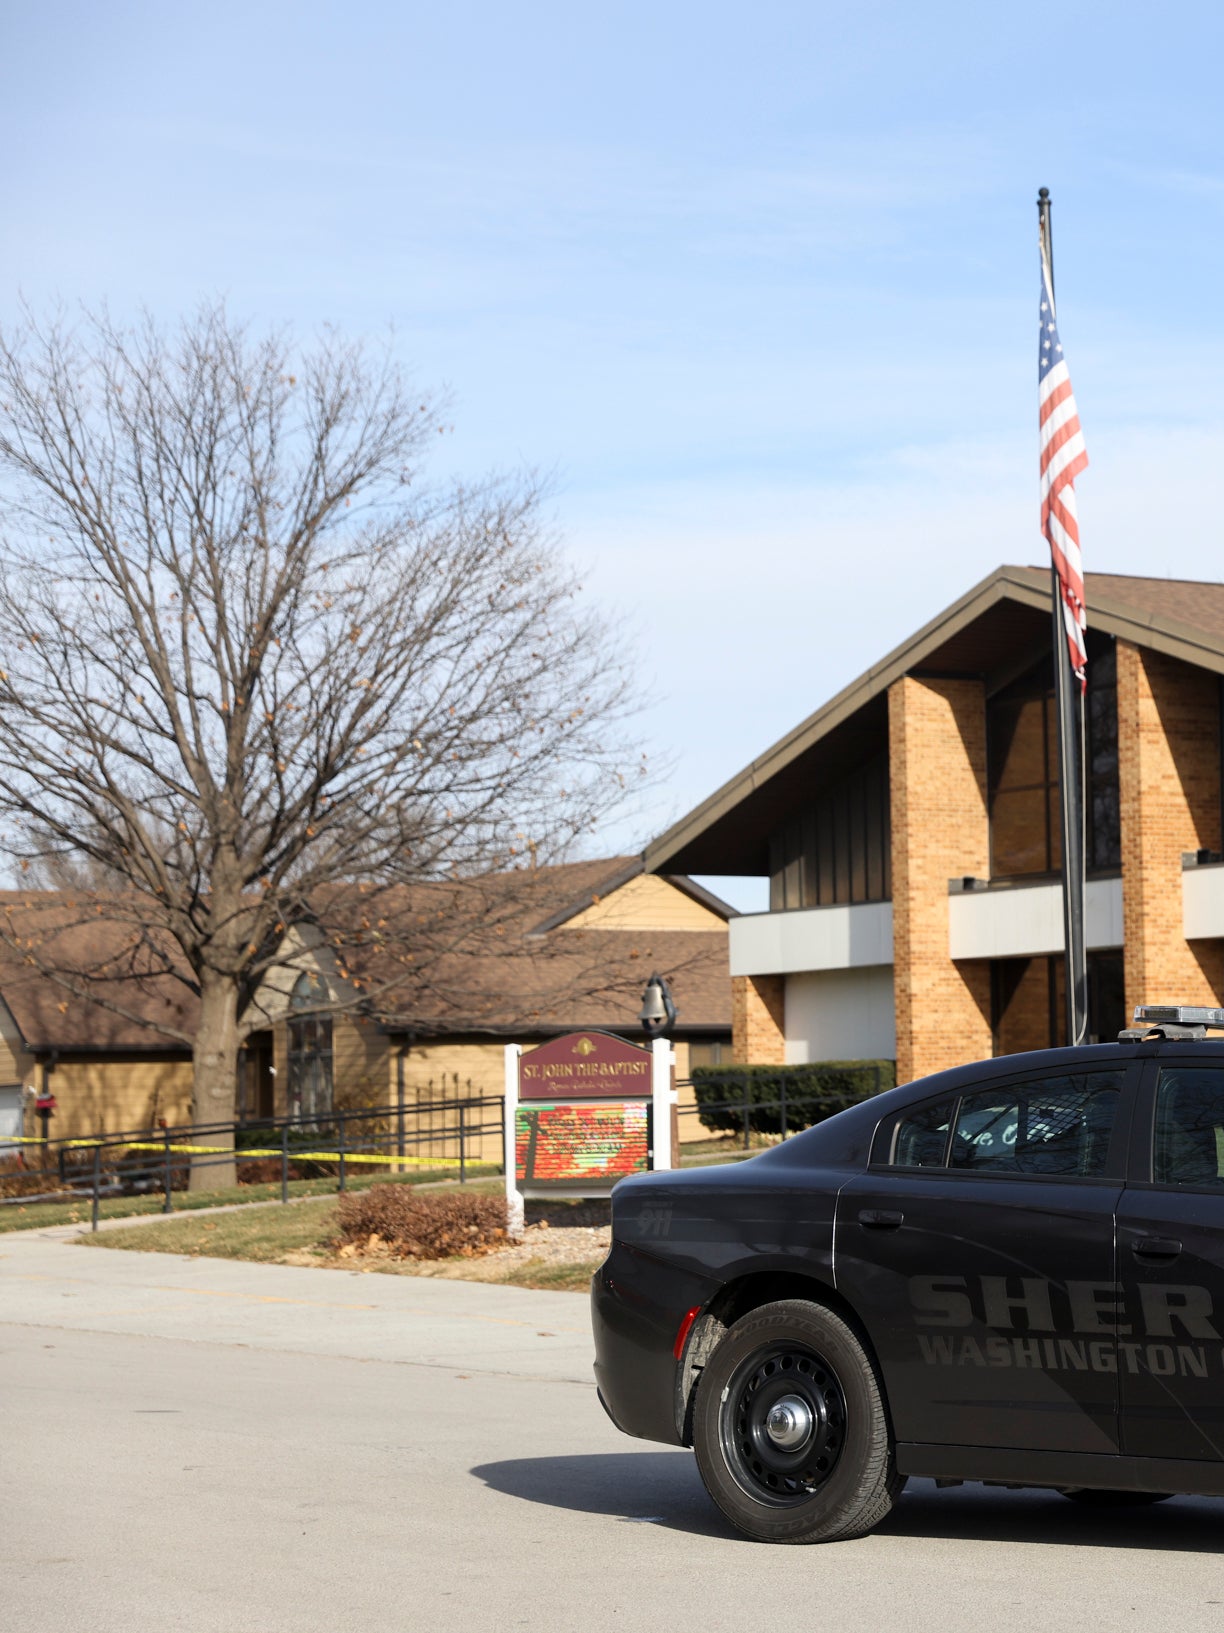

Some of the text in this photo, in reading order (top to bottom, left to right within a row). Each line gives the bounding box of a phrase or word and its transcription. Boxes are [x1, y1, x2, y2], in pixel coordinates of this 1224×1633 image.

[523, 1061, 648, 1080] ST. JOHN THE BAPTIST
[915, 1333, 1209, 1378] WASHINGTON
